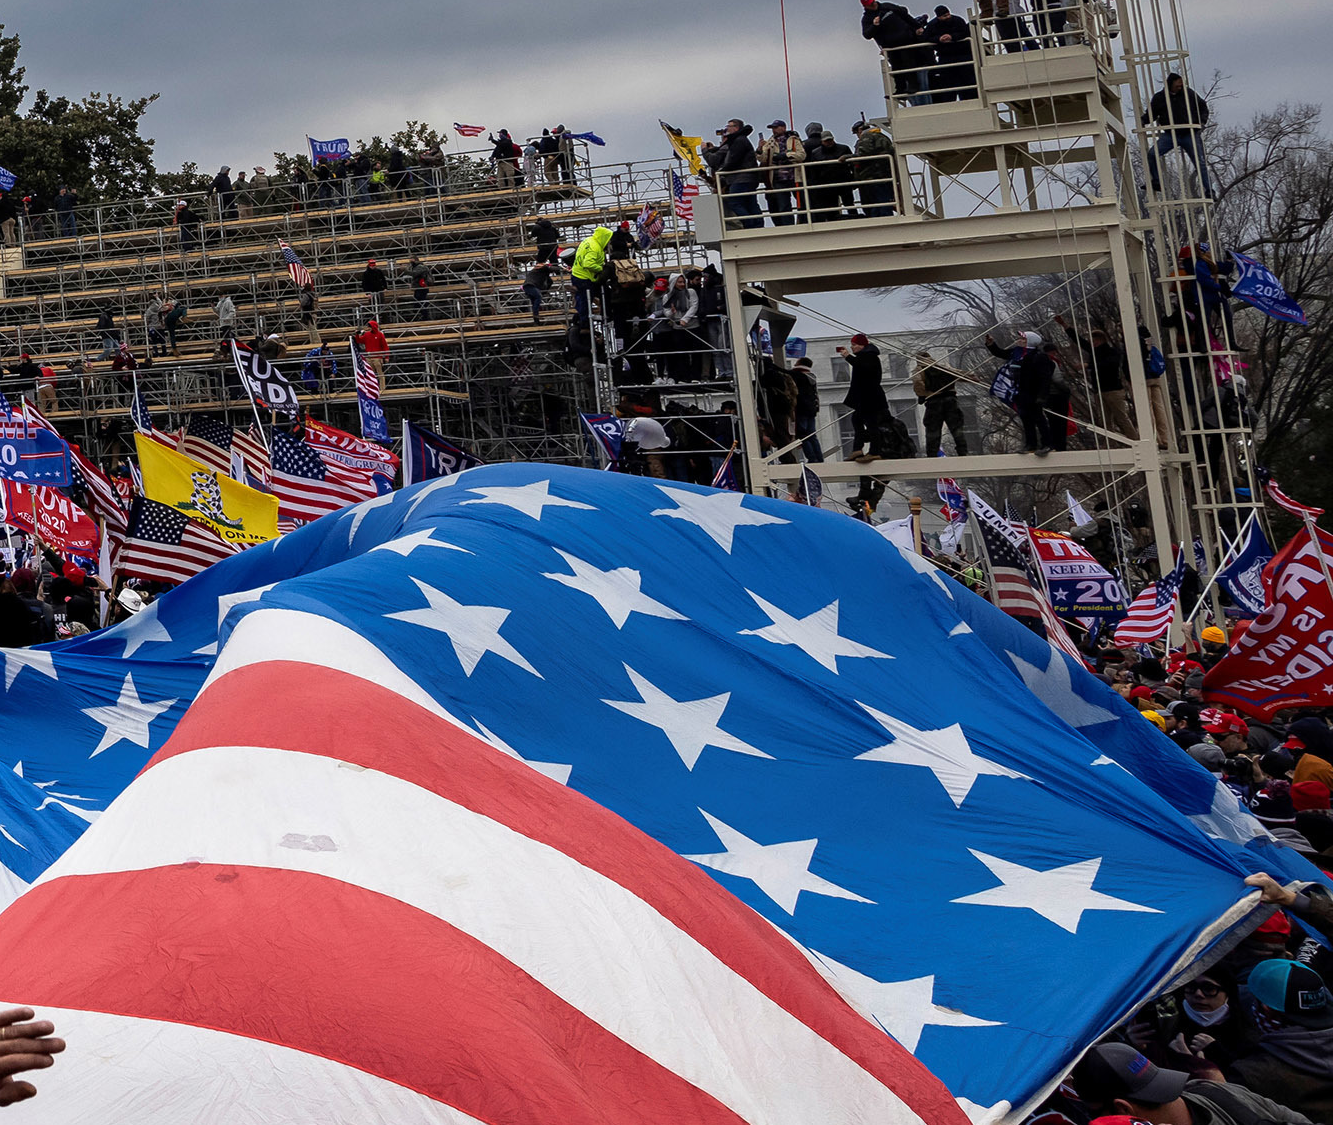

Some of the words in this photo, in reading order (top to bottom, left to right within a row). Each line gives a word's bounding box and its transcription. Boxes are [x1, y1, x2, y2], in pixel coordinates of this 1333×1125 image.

[225, 530, 247, 540] ON
[1049, 564, 1086, 575] KEEP
[1075, 580, 1121, 603] 20
[1073, 604, 1113, 612] President
